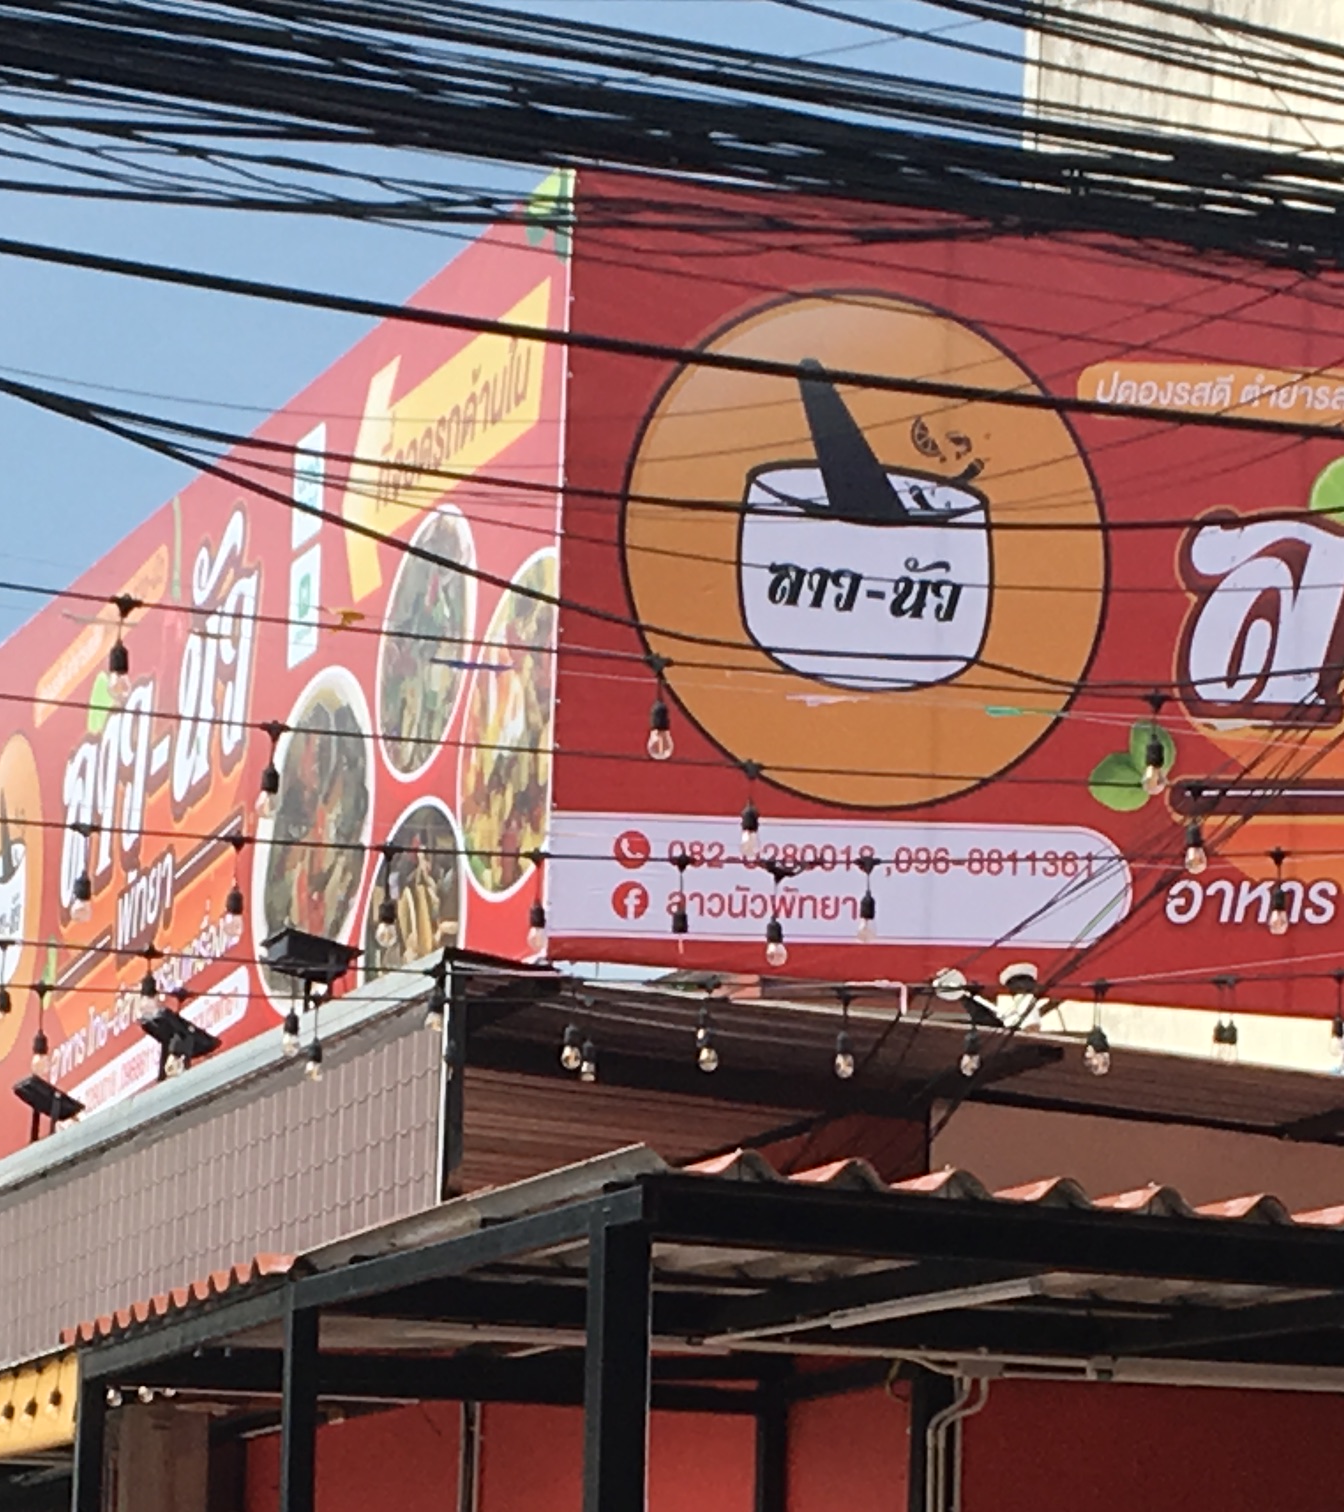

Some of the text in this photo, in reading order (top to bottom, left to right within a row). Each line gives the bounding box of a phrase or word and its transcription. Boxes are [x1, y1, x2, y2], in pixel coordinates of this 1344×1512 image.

[1096, 371, 1235, 406] ปดองรสดี
[767, 556, 964, 622] ลาว-นัว
[1165, 877, 1337, 928] อาหาร
